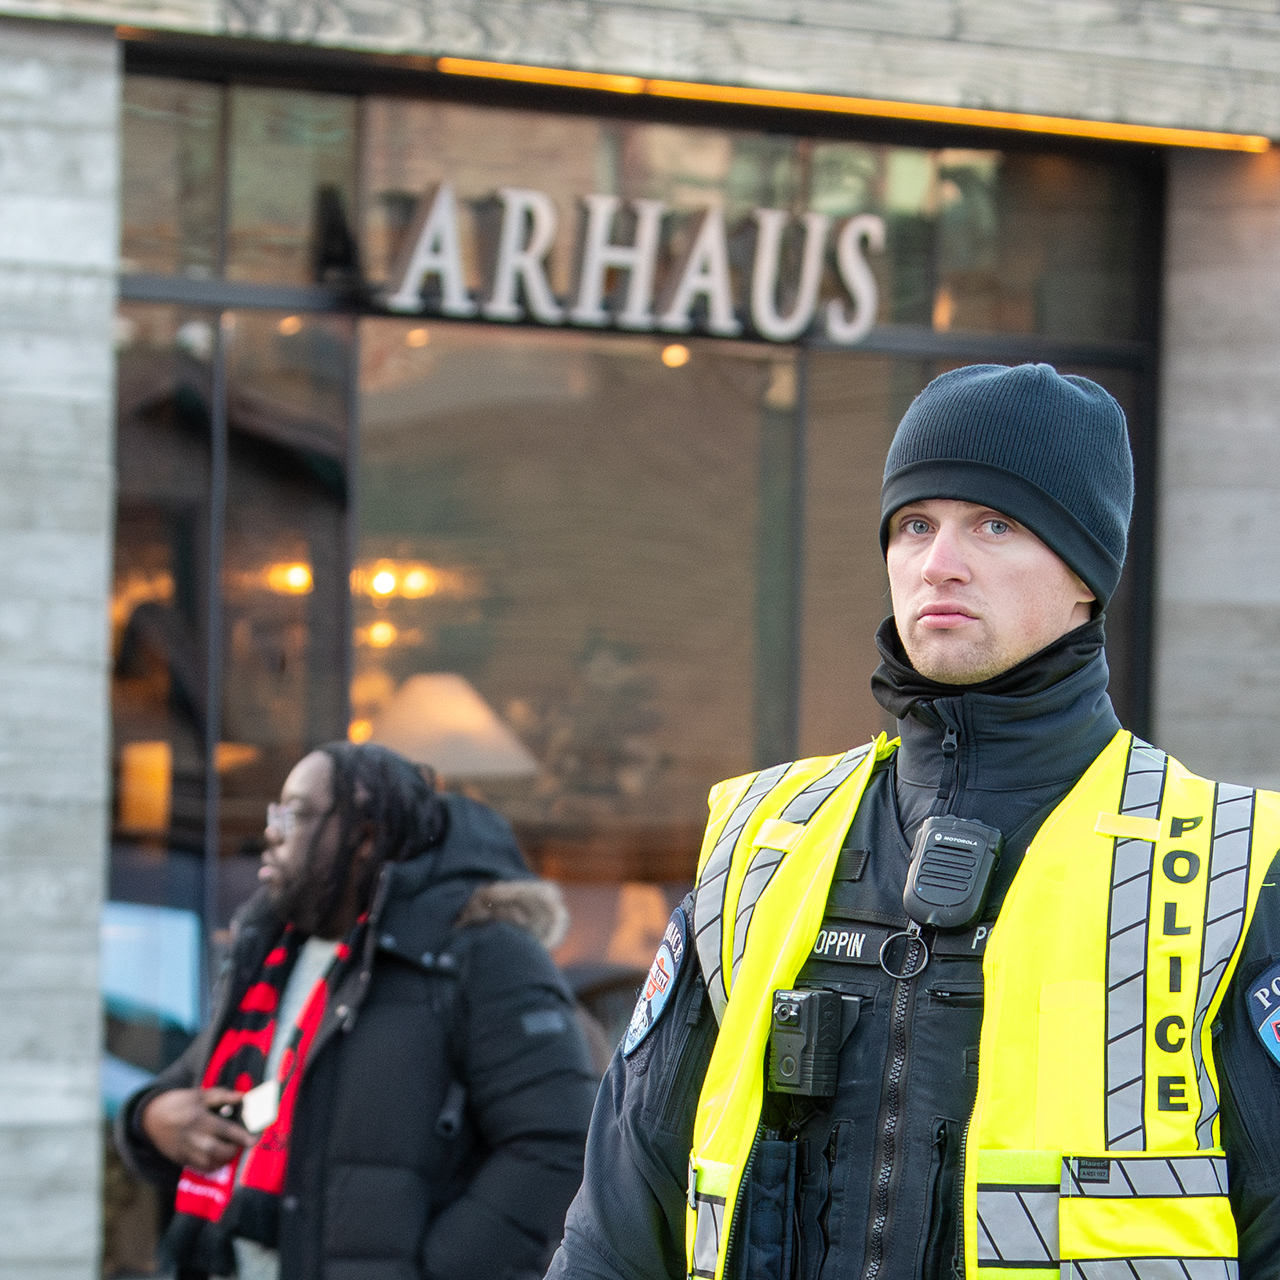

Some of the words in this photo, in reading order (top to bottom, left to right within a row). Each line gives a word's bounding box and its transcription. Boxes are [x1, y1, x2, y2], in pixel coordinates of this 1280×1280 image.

[384, 178, 884, 344] ARHAUS
[943, 835, 978, 847] MOTOROLA
[971, 926, 991, 949] P
[1154, 816, 1203, 1113] POLICE
